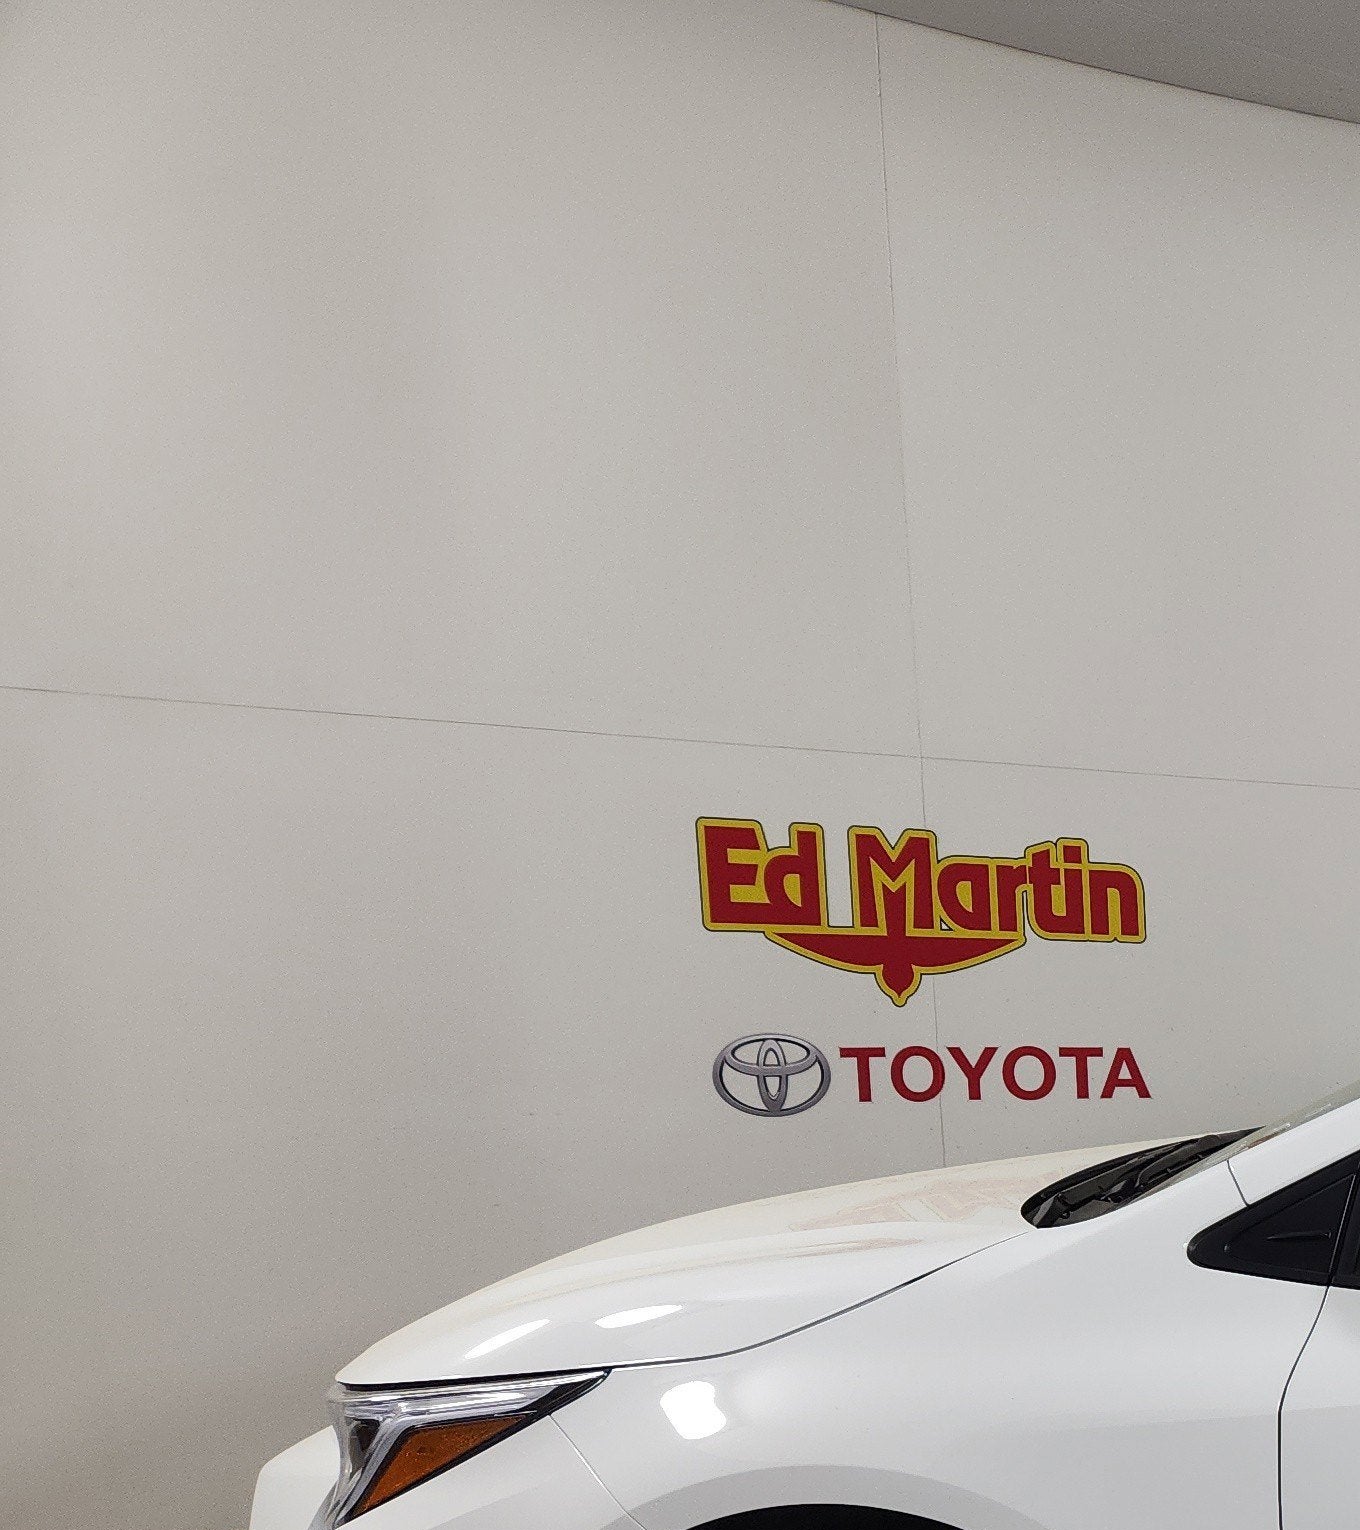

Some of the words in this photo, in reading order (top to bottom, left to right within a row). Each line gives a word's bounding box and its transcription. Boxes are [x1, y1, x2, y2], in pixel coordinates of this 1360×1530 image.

[697, 818, 827, 931] Ed
[849, 826, 1145, 943] Martin
[838, 1045, 1152, 1103] TOYOTA
